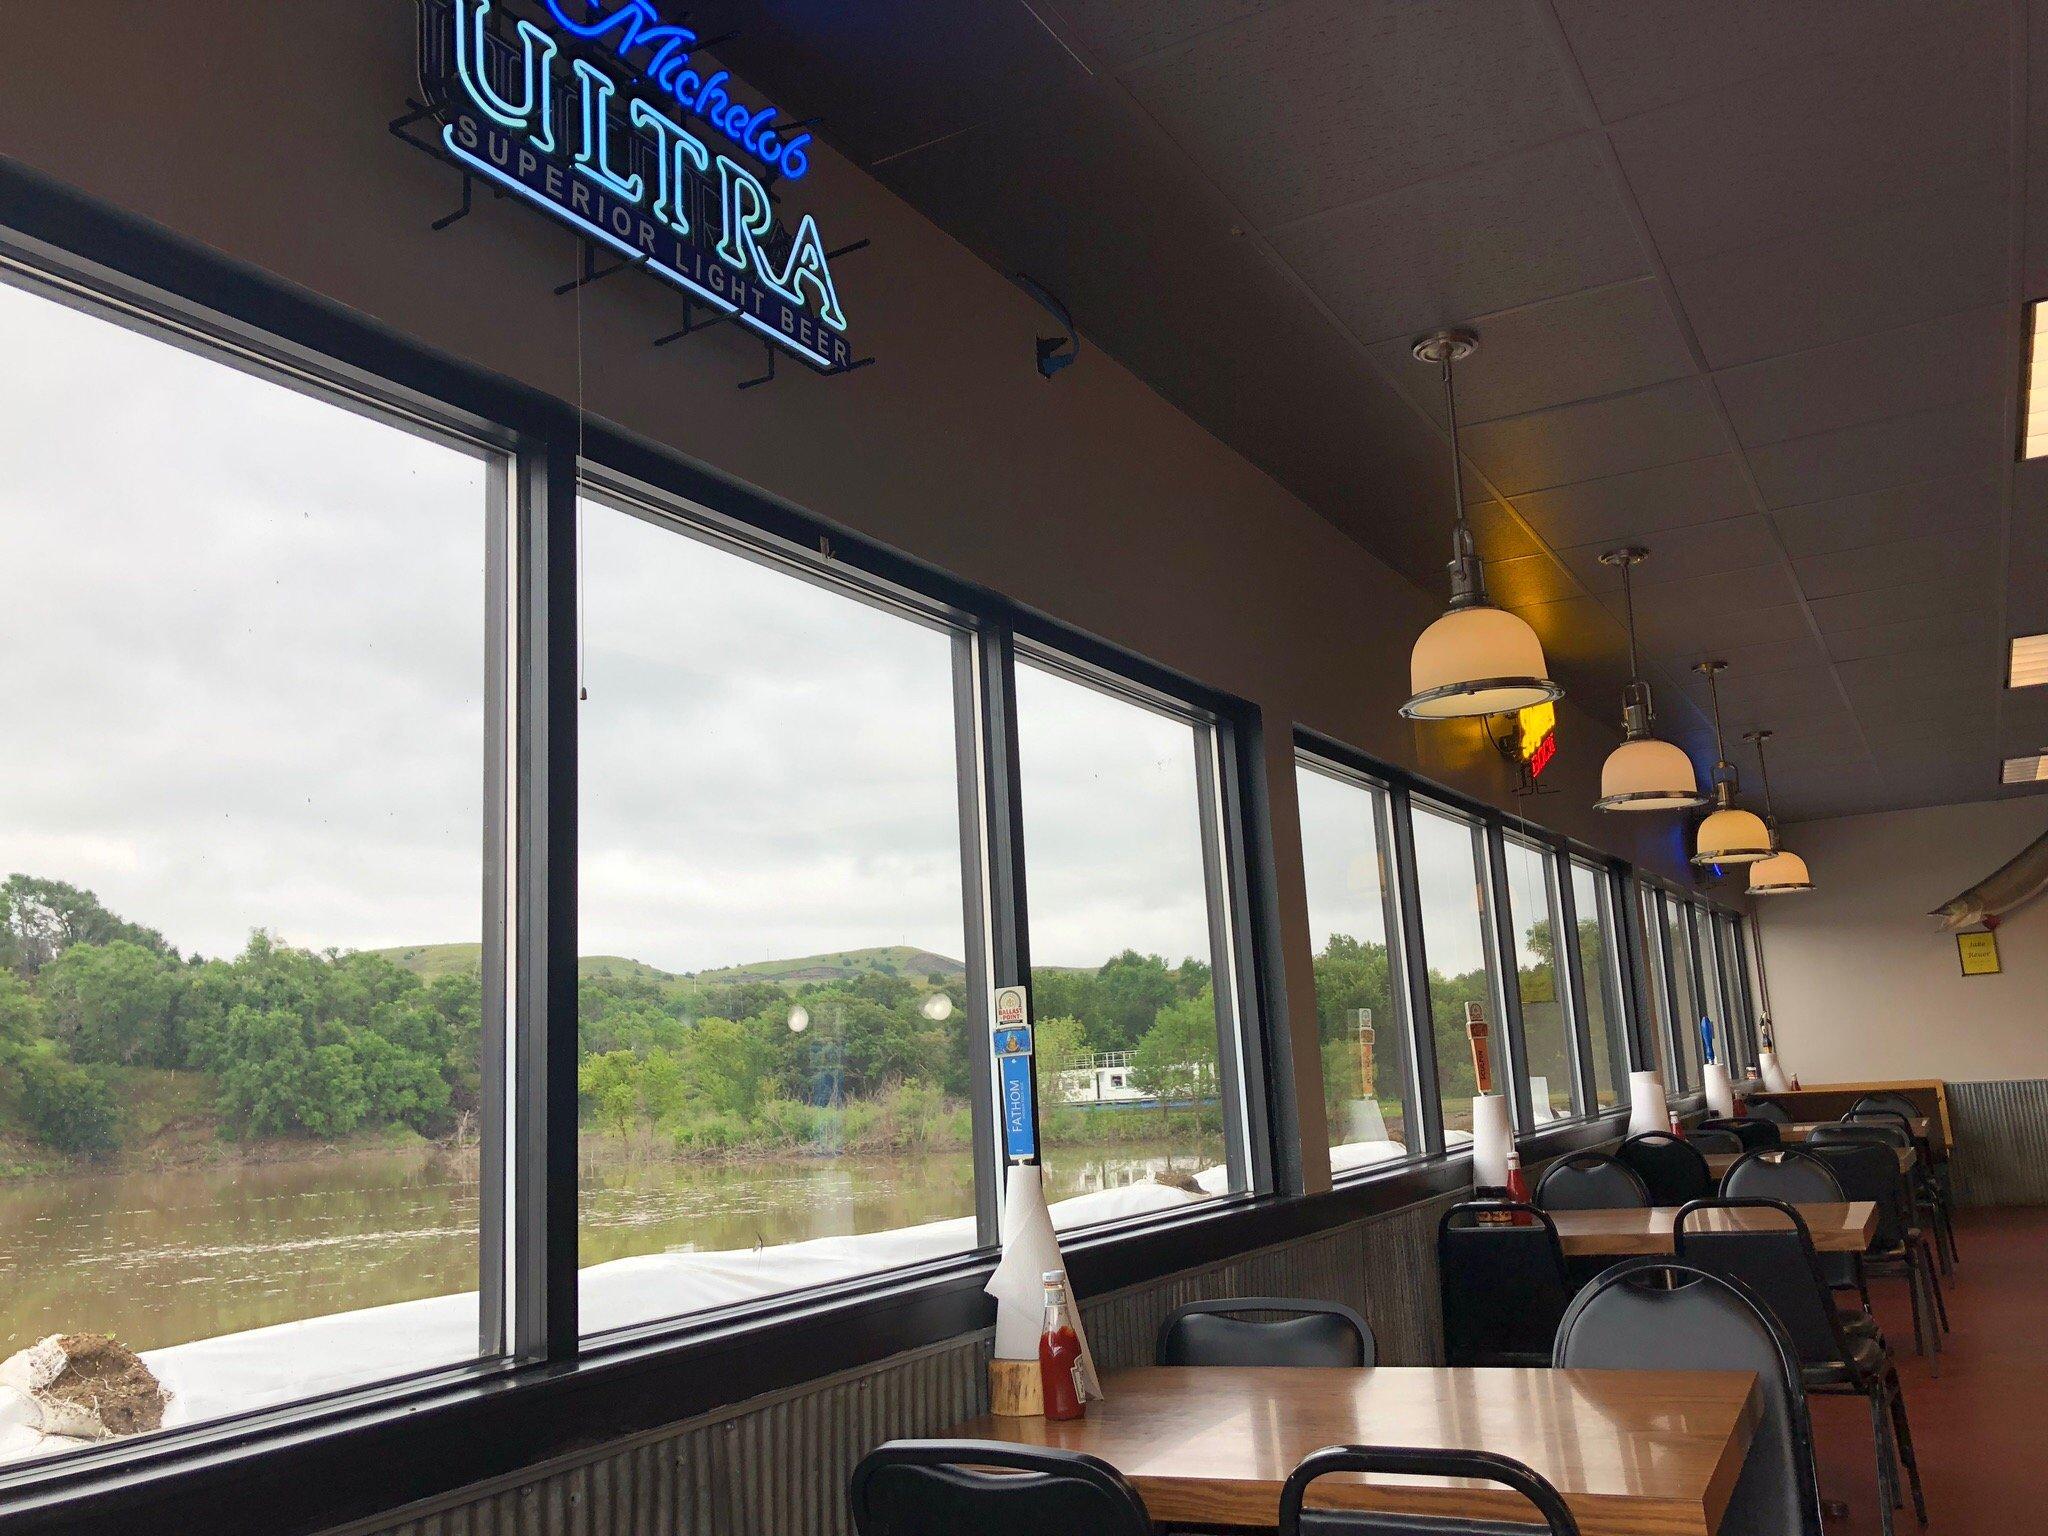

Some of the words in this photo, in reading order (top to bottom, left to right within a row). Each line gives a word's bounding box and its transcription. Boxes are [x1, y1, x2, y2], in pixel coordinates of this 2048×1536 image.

[454, 0, 848, 332] ULTRA
[545, 0, 813, 180] Michelob
[457, 114, 658, 254] SUPERIOR
[674, 249, 766, 316] LIGHT
[780, 308, 848, 367] BEER
[1009, 1079, 1023, 1132] FATHOM
